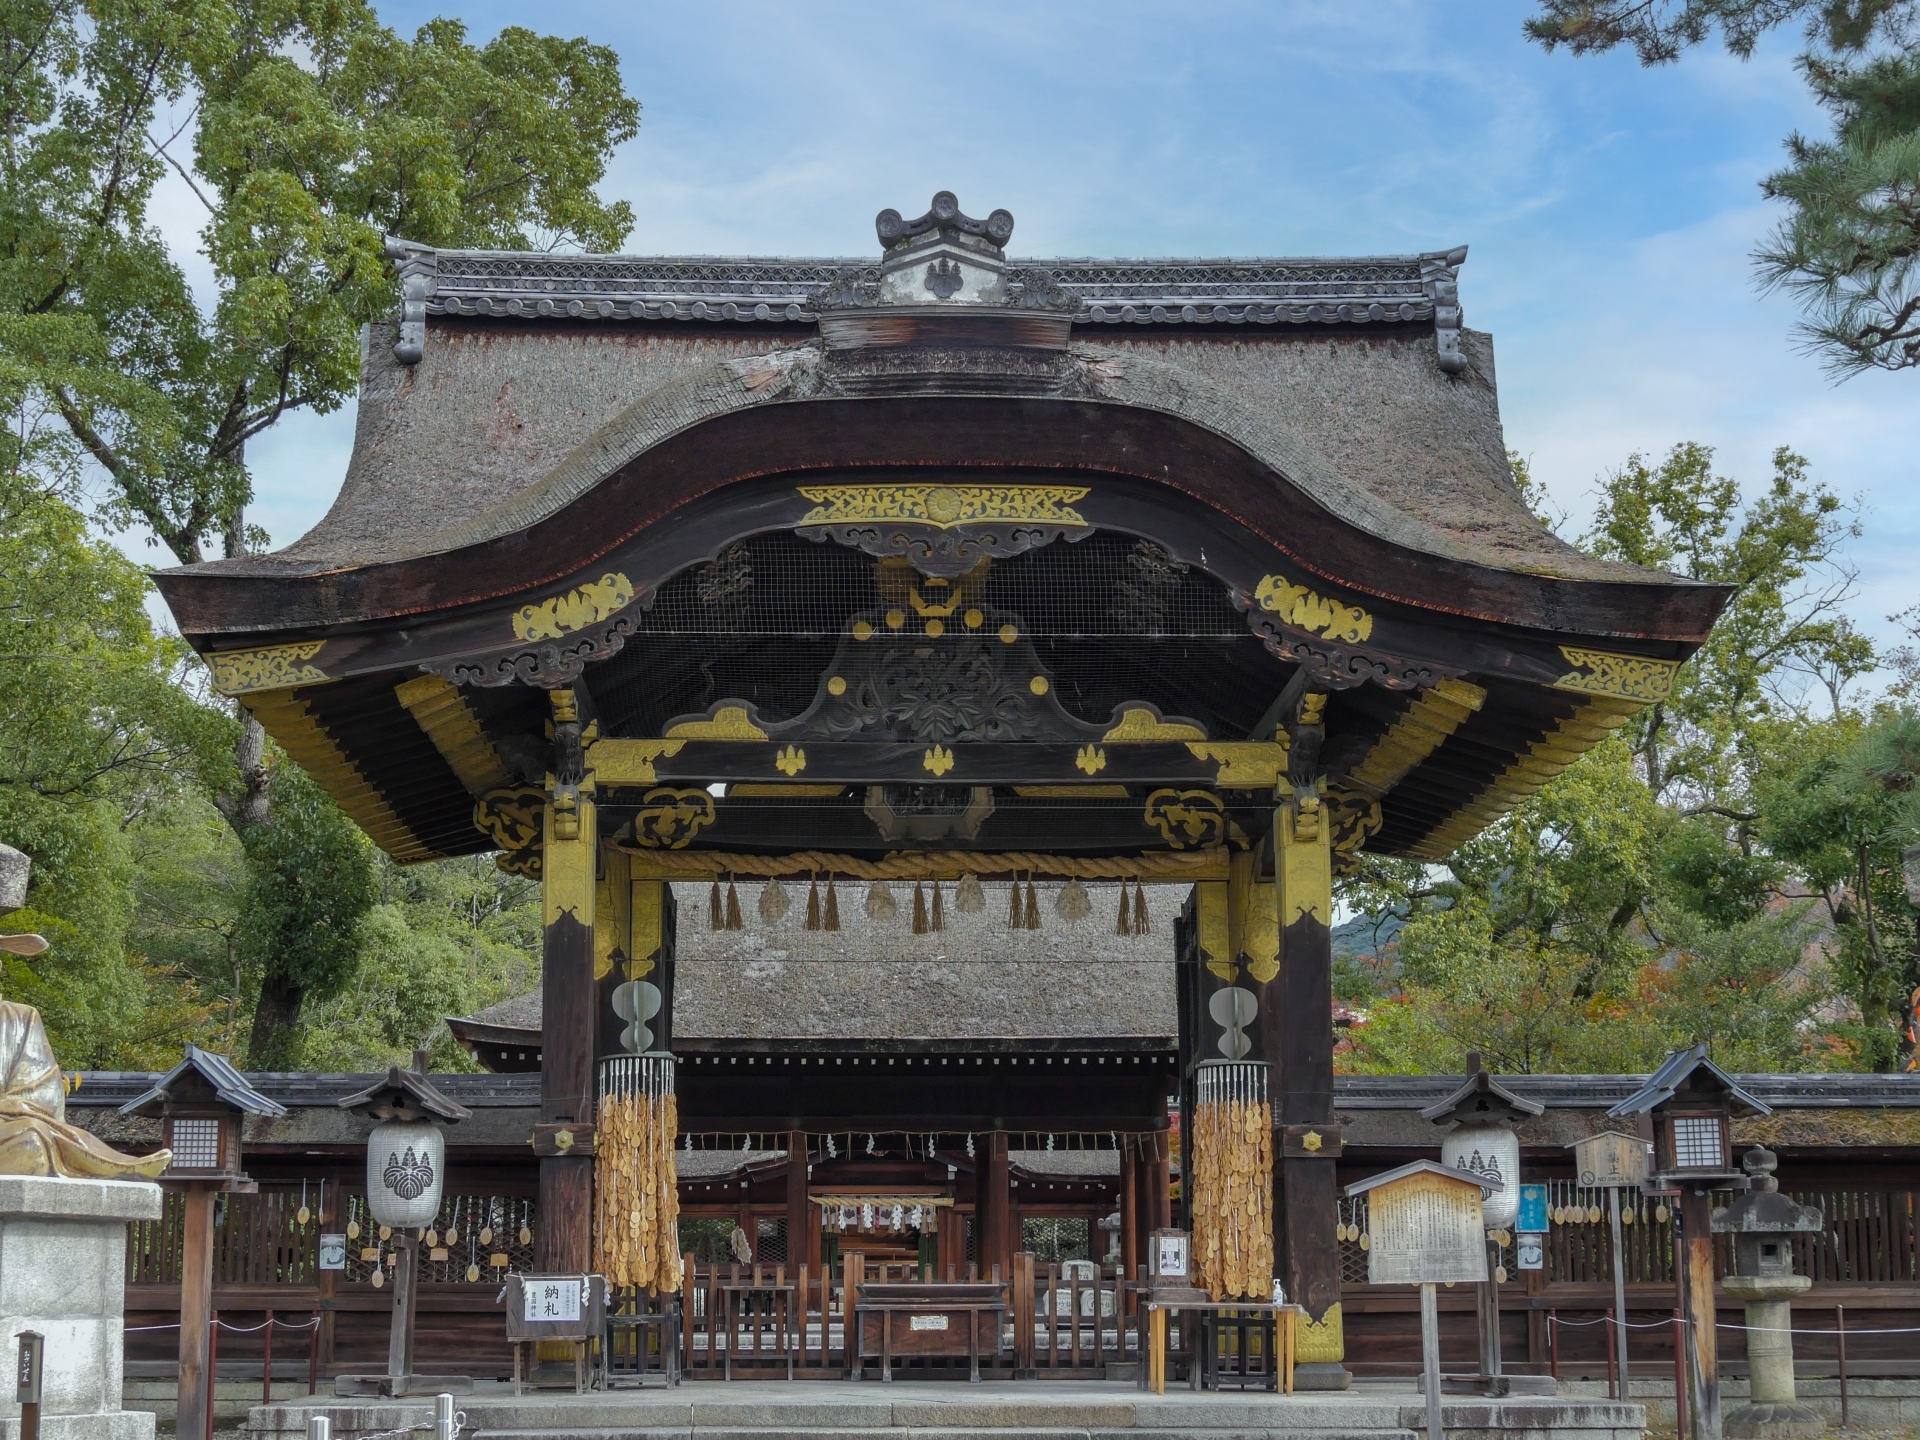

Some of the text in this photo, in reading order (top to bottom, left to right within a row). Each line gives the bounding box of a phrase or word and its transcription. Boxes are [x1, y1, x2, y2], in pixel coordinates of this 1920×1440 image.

[544, 1285, 559, 1316] 納札
[23, 1351, 31, 1382] おさいせん
